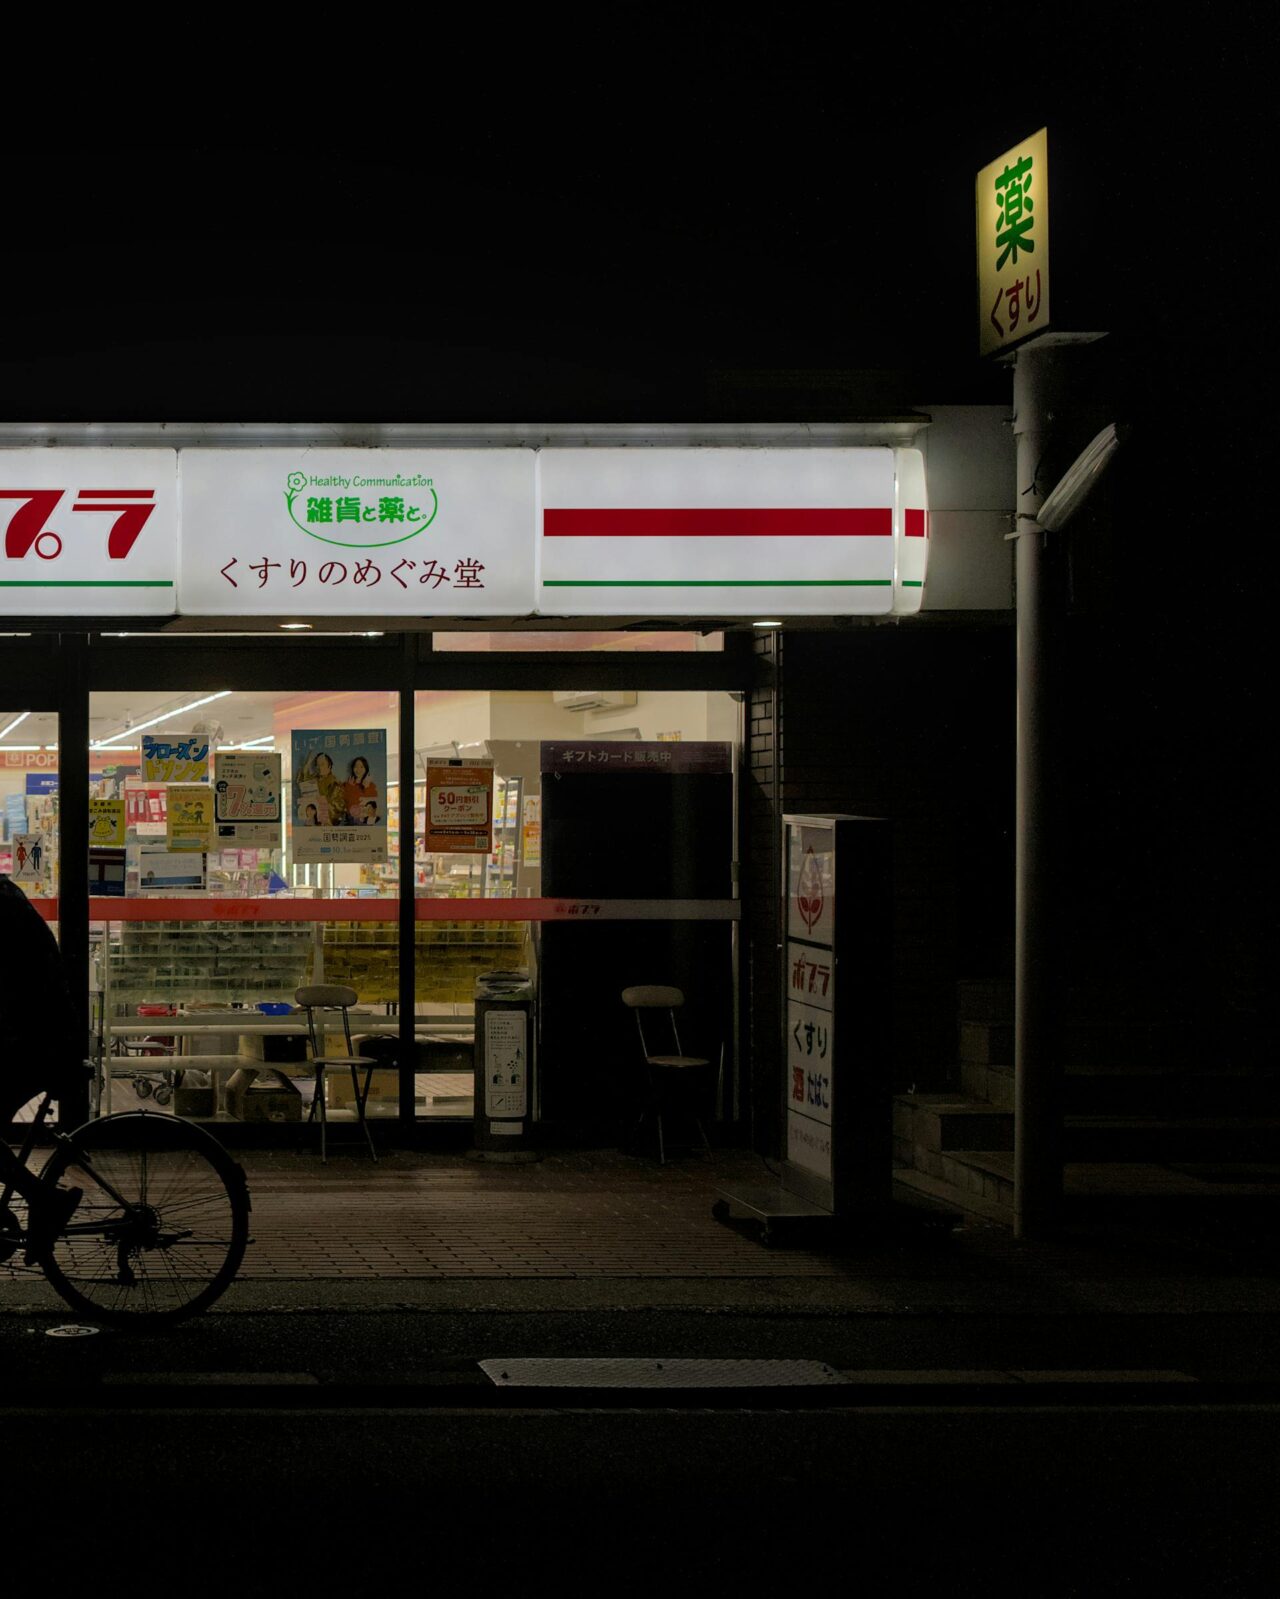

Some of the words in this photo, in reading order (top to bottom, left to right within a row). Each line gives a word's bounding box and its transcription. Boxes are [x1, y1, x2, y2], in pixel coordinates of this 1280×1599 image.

[995, 156, 1035, 272] 薬
[990, 269, 1041, 338] くすり
[309, 474, 350, 490] Healthy
[352, 473, 434, 488] Communication
[220, 556, 487, 590] くすりのめぐみ堂
[26, 753, 58, 767] POP
[143, 738, 209, 762] フローズン
[562, 750, 673, 763] ギフトカード販売中
[438, 791, 480, 805] 50円割引
[567, 903, 601, 915] ポプラ
[792, 953, 830, 996] ポプラ
[793, 1018, 827, 1059] くすり
[807, 1073, 829, 1109] たばこ
